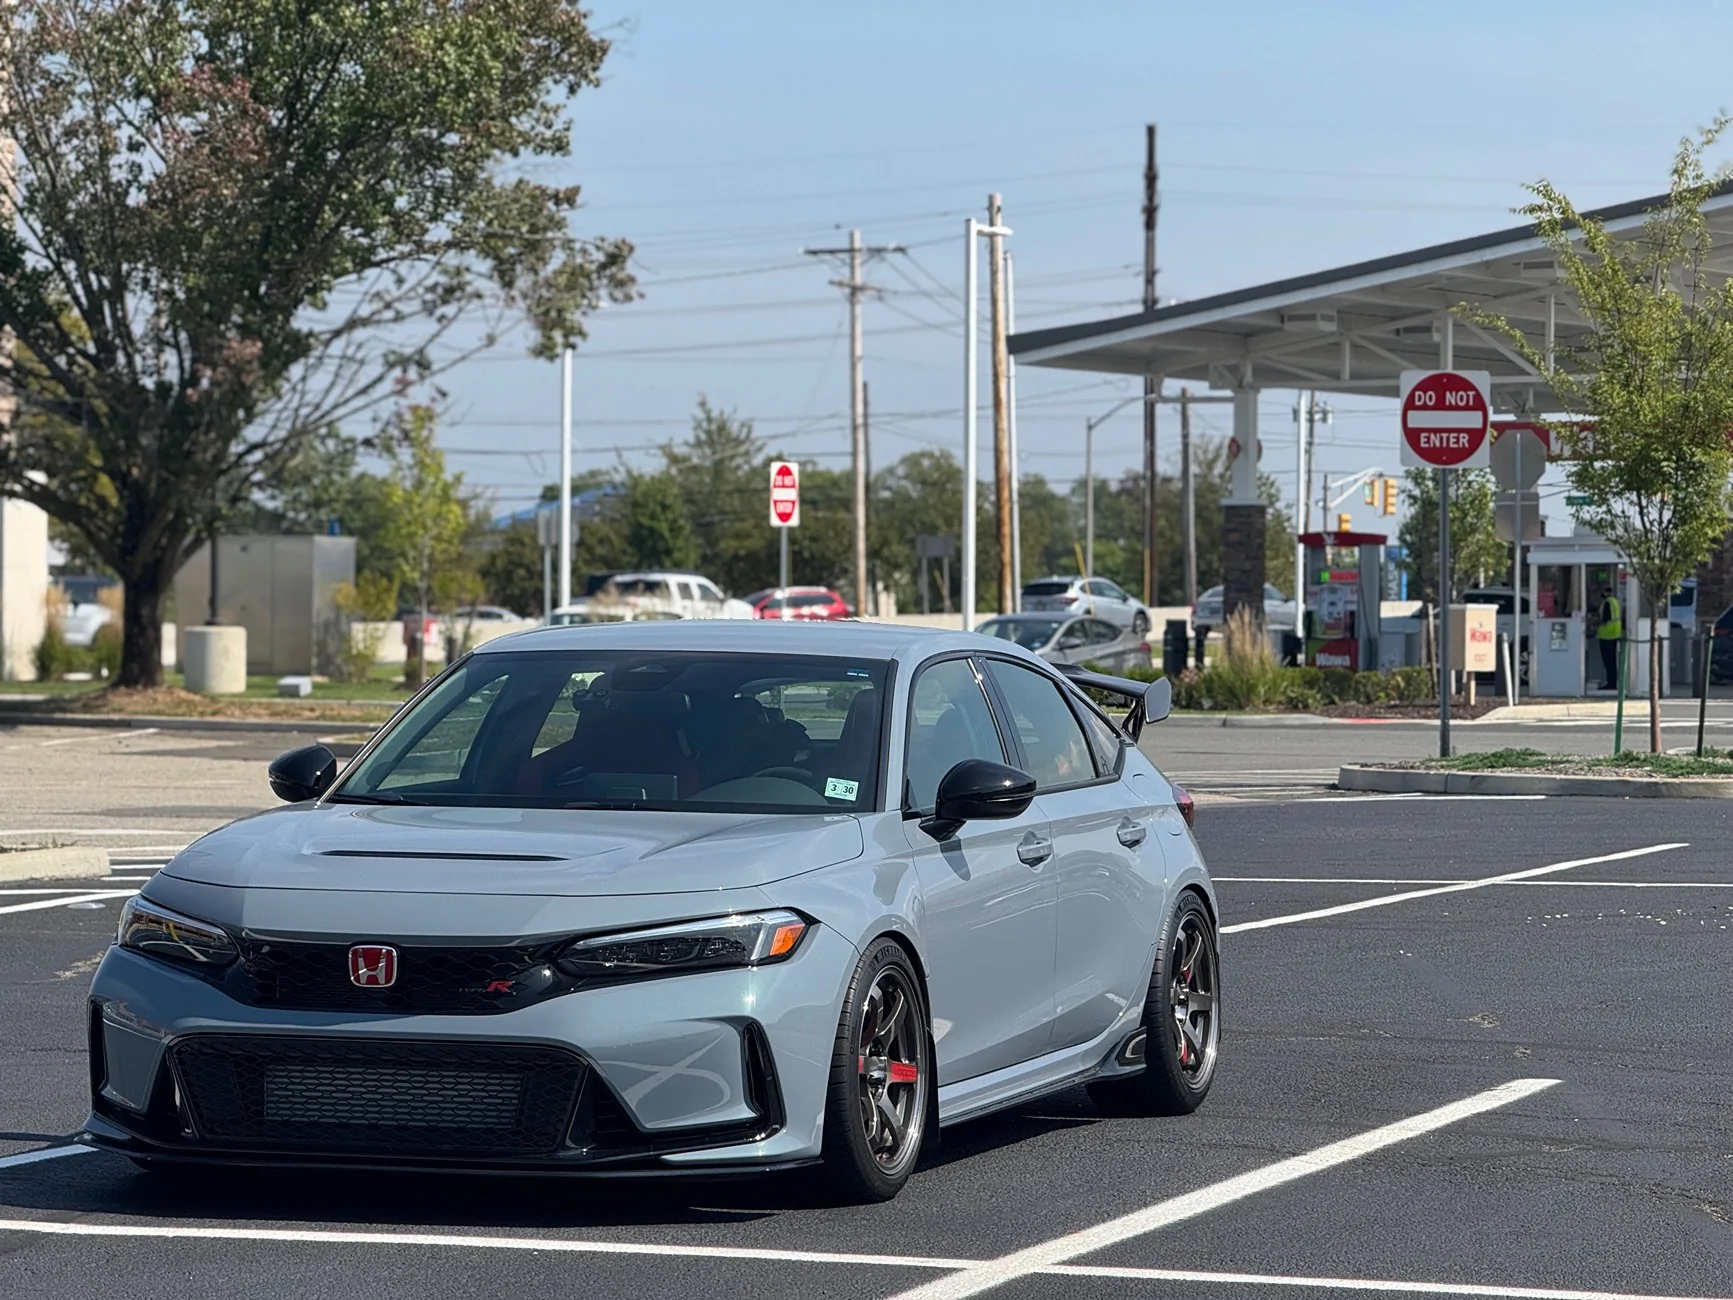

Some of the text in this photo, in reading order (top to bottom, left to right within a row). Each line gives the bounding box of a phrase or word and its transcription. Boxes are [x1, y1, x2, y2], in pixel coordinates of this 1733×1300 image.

[1414, 391, 1476, 406] DO NOT
[1420, 432, 1469, 448] ENTER
[775, 474, 794, 487] DO NOT
[776, 501, 793, 513] ENTER
[1387, 562, 1399, 600] HASE
[842, 786, 854, 794] 30
